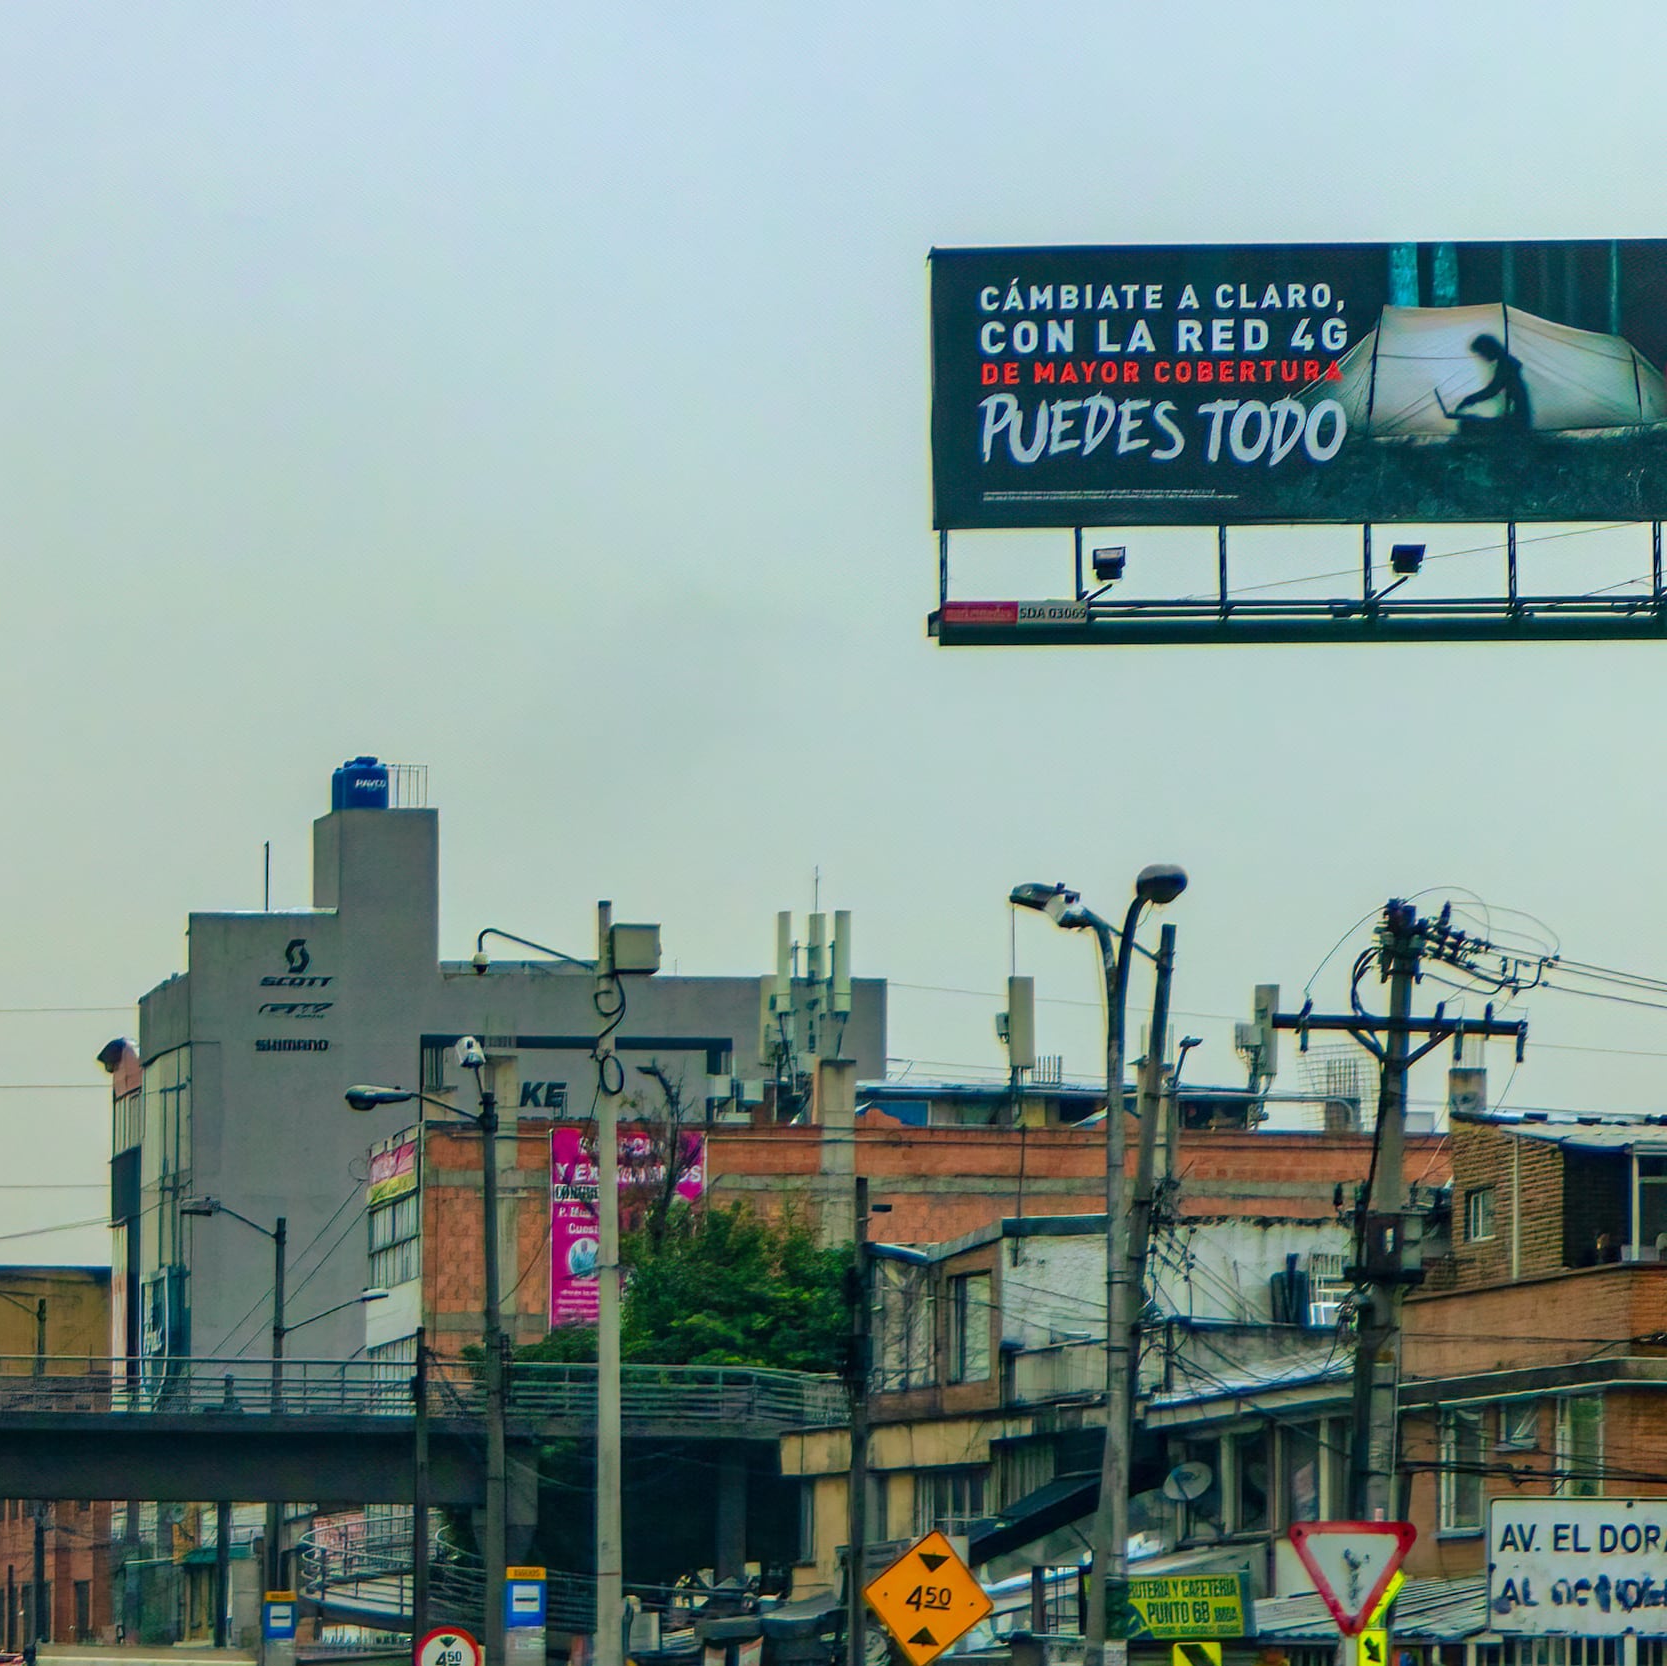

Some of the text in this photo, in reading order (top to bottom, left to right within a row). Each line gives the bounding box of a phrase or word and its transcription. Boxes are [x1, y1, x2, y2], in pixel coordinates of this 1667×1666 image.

[980, 277, 1346, 313] CÁMBIATE A CLARO,
[980, 317, 1349, 353] CON LA RED 4G
[981, 359, 1344, 385] DE MAYOR COBERTURA
[979, 390, 1348, 467] PUEDES TODO
[259, 976, 334, 987] SCOTT
[255, 1039, 329, 1052] SHIMANO
[1498, 1523, 1667, 1553] AV. EL DOR
[1147, 1601, 1189, 1624] PUNTO
[1192, 1601, 1211, 1623] 68
